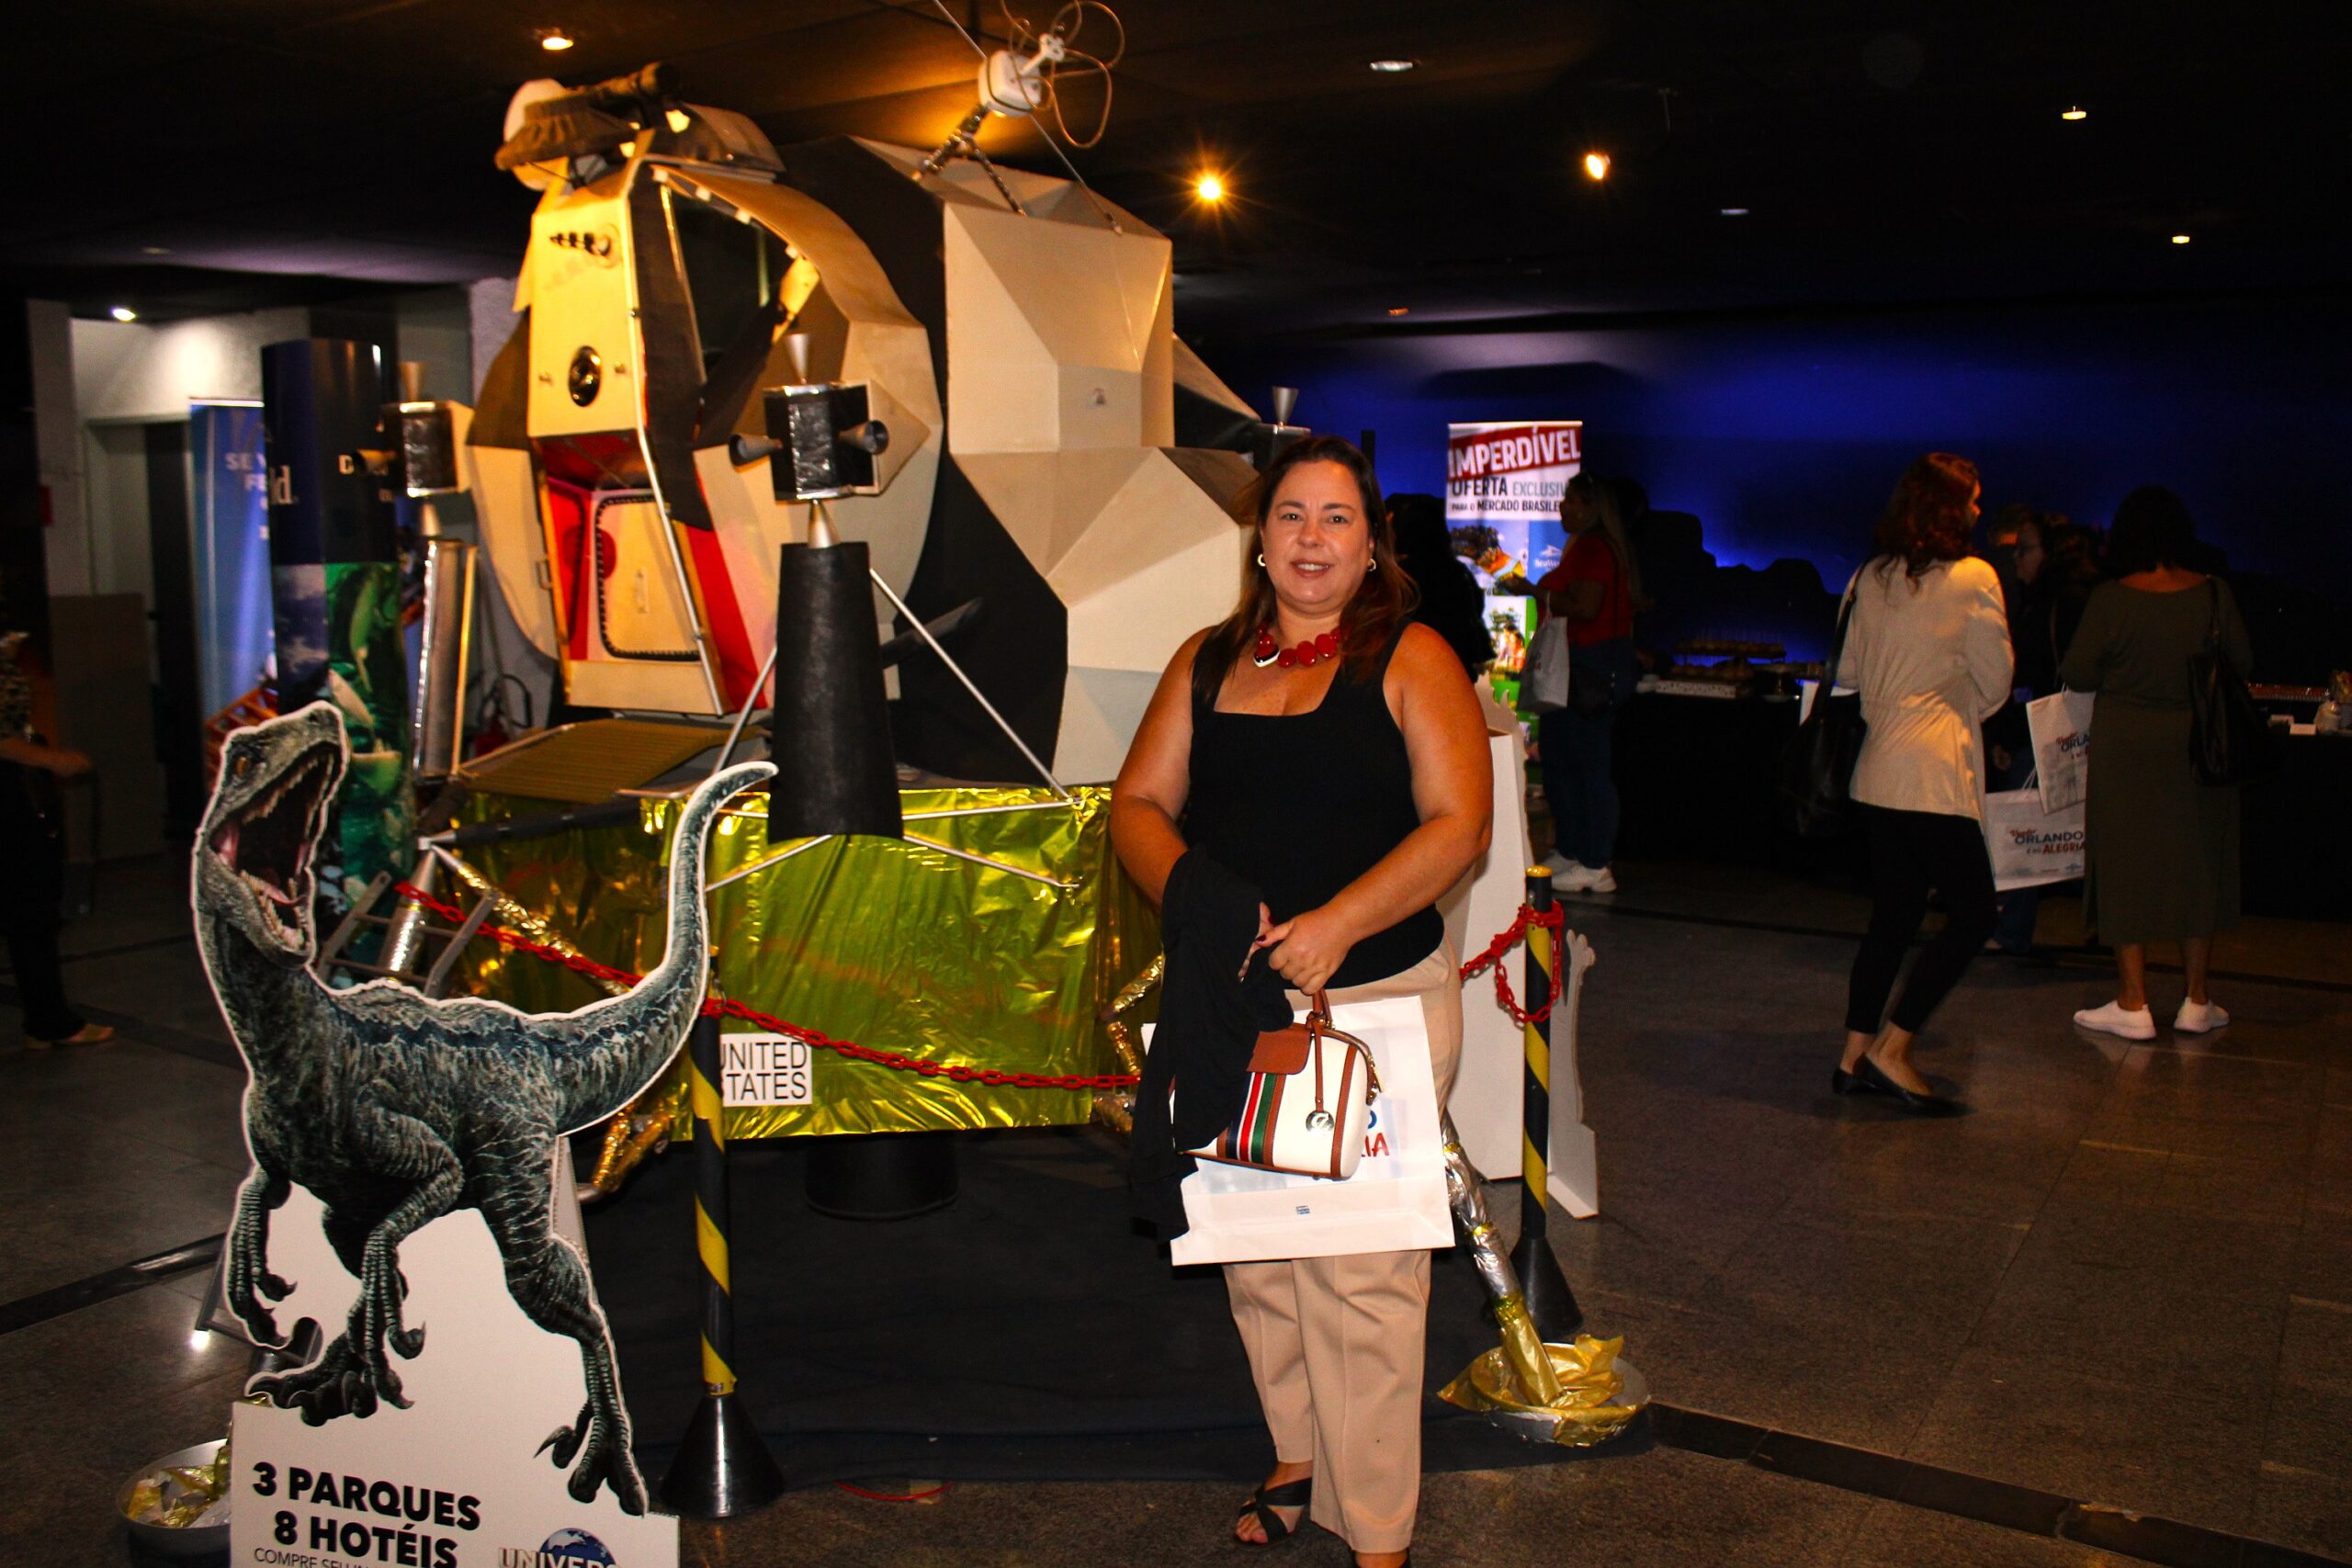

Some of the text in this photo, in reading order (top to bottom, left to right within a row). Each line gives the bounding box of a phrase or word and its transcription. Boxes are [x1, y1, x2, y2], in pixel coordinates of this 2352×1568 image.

[1448, 425, 1580, 478] IMPERDÍVEL
[1452, 476, 1567, 497] OFERTA EXCLUSIV
[1477, 498, 1520, 512] MERCADO
[1521, 499, 1559, 513] BRASILE
[2061, 734, 2088, 752] ORLA
[2015, 830, 2084, 845] ORLANDO
[726, 1072, 807, 1100] TATES
[253, 1461, 481, 1531] 3 PARQUES
[275, 1510, 458, 1568] 8 HOTÉIS
[254, 1547, 317, 1568] COMPRE
